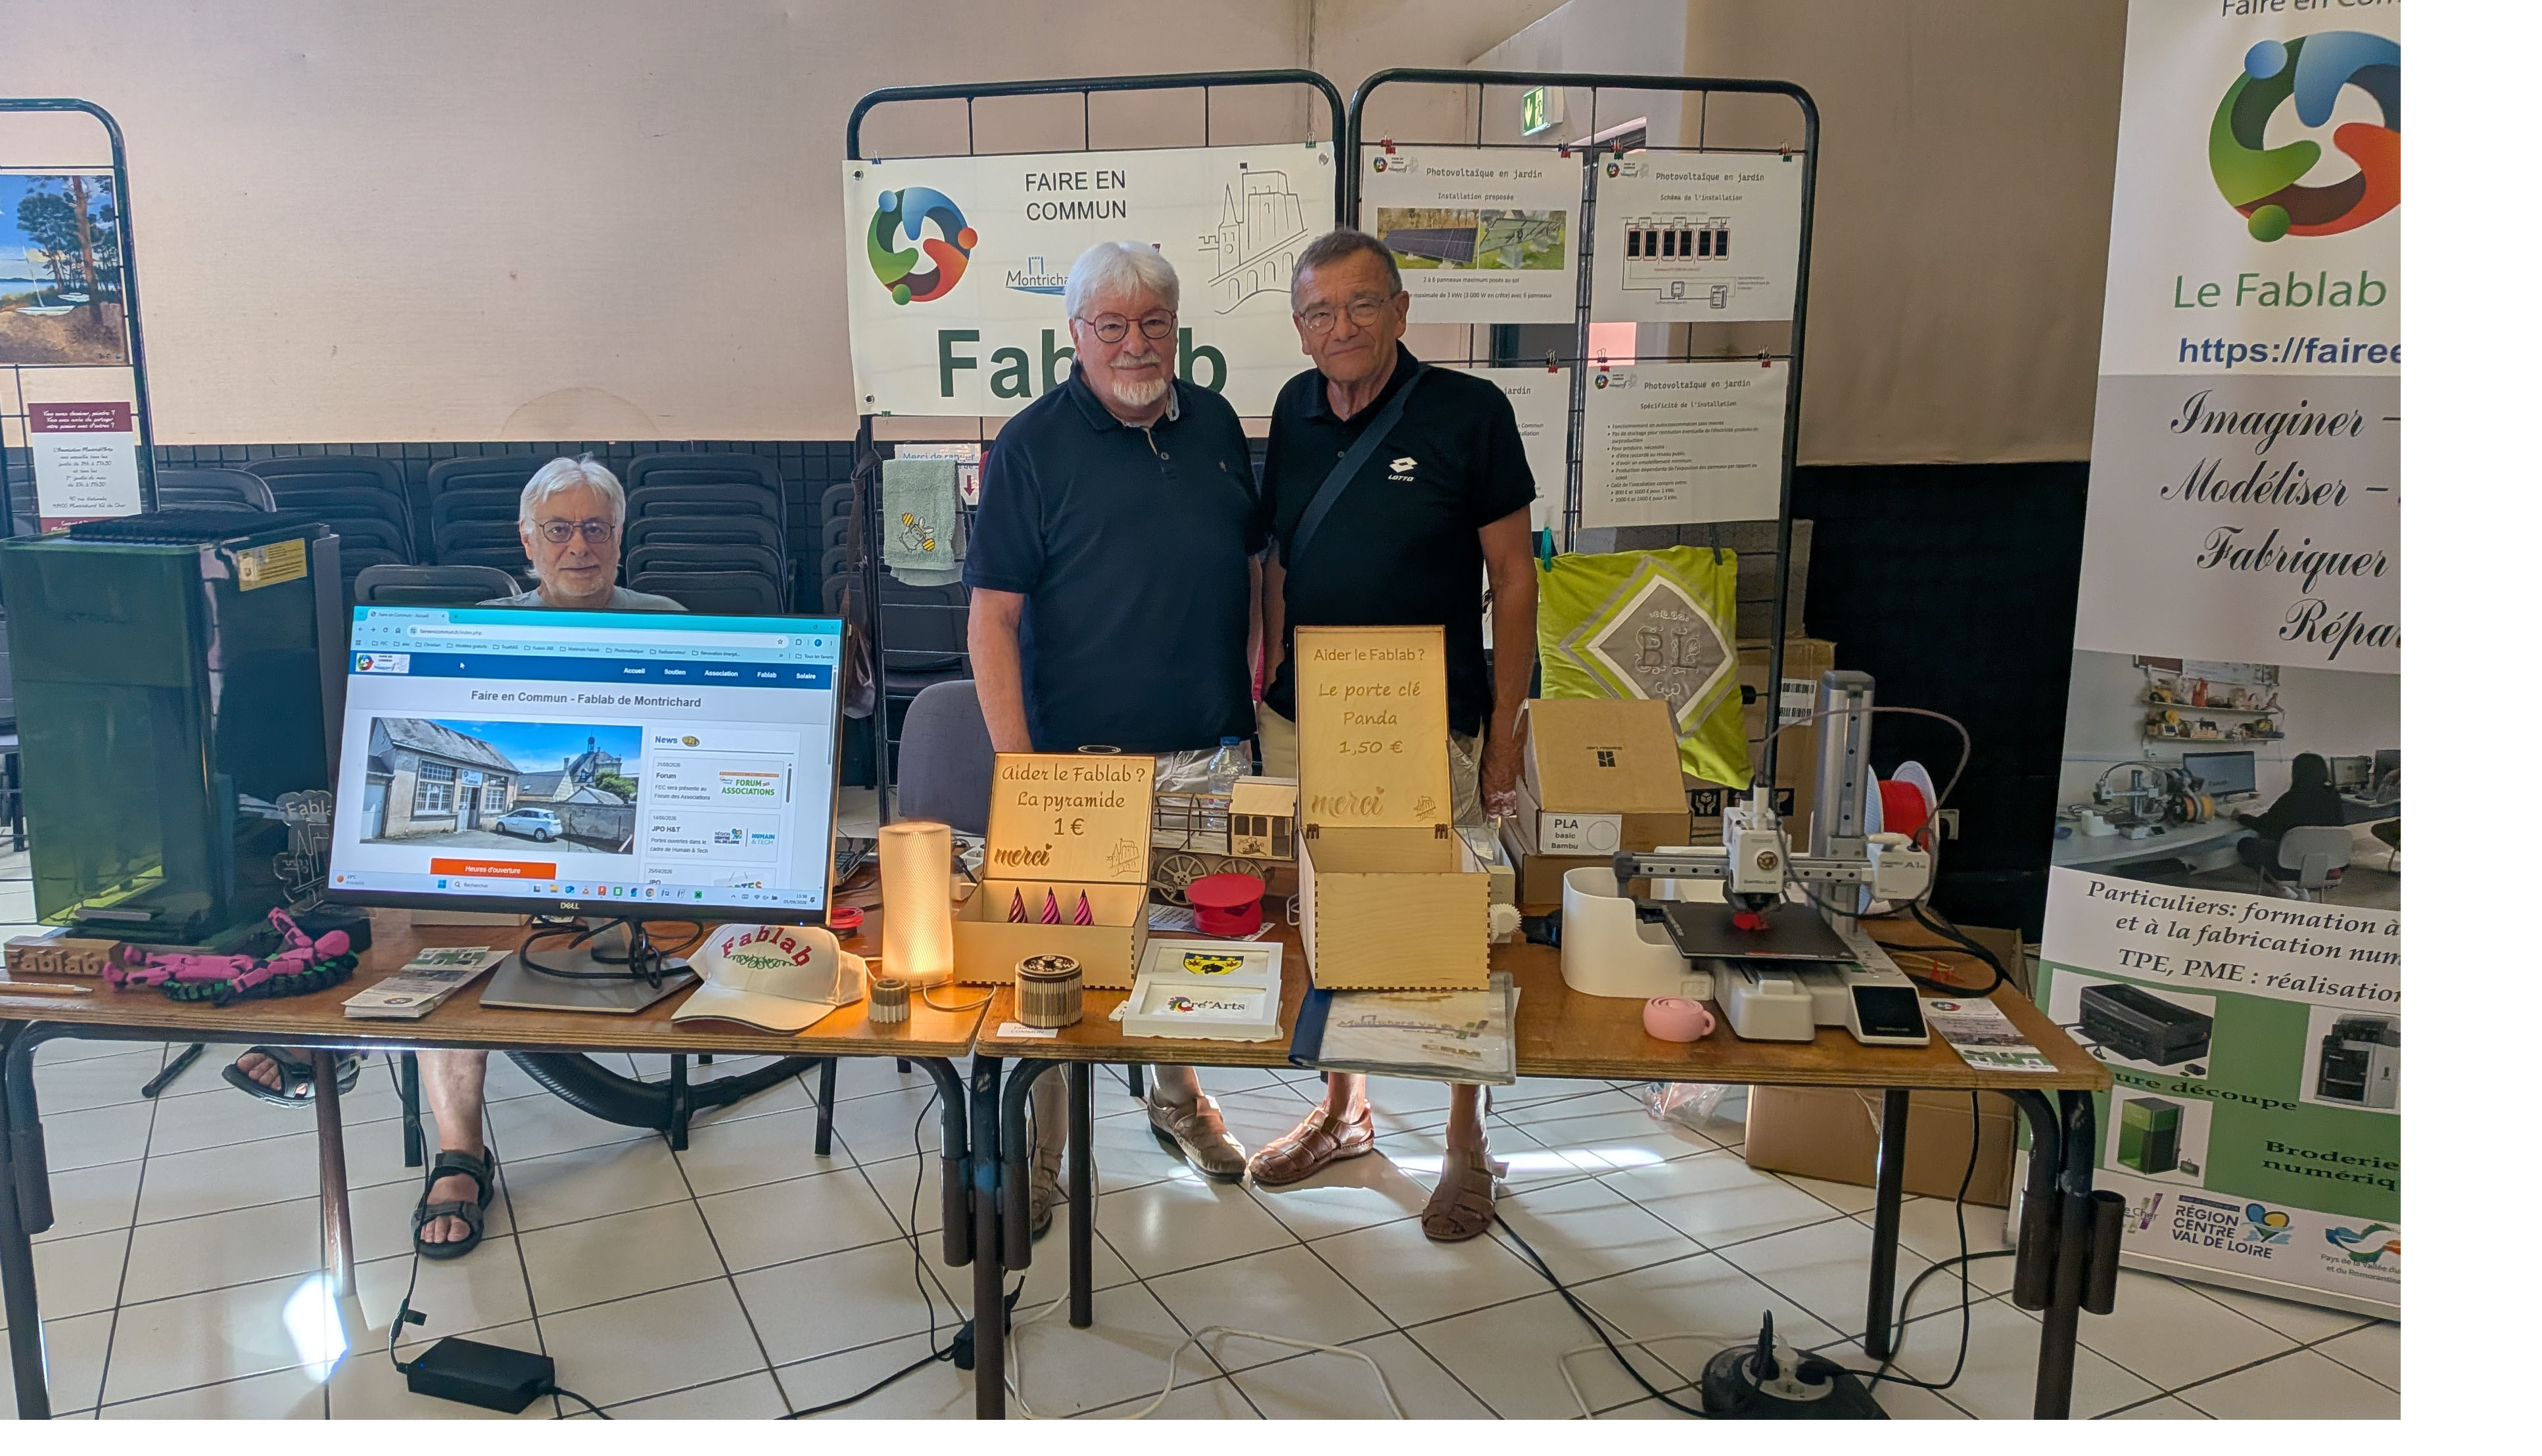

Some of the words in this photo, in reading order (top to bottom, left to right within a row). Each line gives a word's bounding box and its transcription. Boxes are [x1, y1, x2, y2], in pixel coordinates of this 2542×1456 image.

[1025, 171, 1091, 193] FAIRE
[1096, 169, 1127, 190] EN
[1426, 167, 1494, 179] Photovoltaïque
[1513, 169, 1543, 179] jardin
[1656, 172, 1720, 183] Photovoltaïque
[1738, 173, 1764, 183] jardin
[1025, 199, 1127, 222] COMMUN
[2175, 274, 2221, 309] Le
[2236, 270, 2387, 308] Fablab
[938, 327, 1227, 398] Fabb
[1643, 381, 1707, 390] Photovoltaïque
[1724, 379, 1751, 389] jardin
[2171, 390, 2365, 456] Imaginer
[2160, 458, 2349, 506] Modéliser
[2197, 526, 2390, 594] Fabriquer
[2279, 598, 2401, 661] Répa
[1313, 648, 1352, 661] Aider
[1355, 648, 1367, 661] le
[1370, 648, 1415, 661] Fablab
[1418, 648, 1424, 661] ?
[471, 690, 499, 701] Faire
[501, 693, 515, 702] en
[517, 692, 567, 703] Commun
[577, 693, 615, 705] Fablab
[617, 695, 631, 705] de
[634, 695, 701, 708] Montrichard
[1318, 684, 1337, 697] Le
[1344, 684, 1391, 702] porte
[1398, 681, 1421, 696] clé
[1344, 710, 1398, 726] Panda
[655, 735, 678, 744] News
[1338, 741, 1382, 756] 1,50
[1390, 740, 1403, 754] €
[1002, 763, 1050, 780] Aider
[1054, 764, 1068, 782] le
[1072, 764, 1131, 783] Fablab
[1136, 767, 1146, 783] ?
[721, 787, 775, 796] ASSOCIATIONS
[1018, 791, 1040, 807] La
[1043, 791, 1125, 812] pyramide
[1311, 786, 1386, 818] merci
[1054, 818, 1064, 835] 1
[1070, 818, 1085, 836] €
[1554, 818, 1579, 829] PLA
[993, 842, 1053, 868] merci
[464, 864, 486, 873] Heures
[487, 866, 521, 875] d'ouverture
[560, 901, 580, 910] DELL
[2086, 880, 2238, 917] Particuliers:
[2239, 901, 2375, 936] formation
[2384, 918, 2401, 937] à
[721, 925, 813, 968] Fablab
[2115, 915, 2139, 931] et
[2144, 917, 2159, 935] à
[2167, 920, 2190, 940] la
[2192, 923, 2342, 959] fabrication
[4, 947, 105, 976] Fablab
[2118, 947, 2174, 977] TPE,
[2181, 959, 2246, 983] PME
[2265, 1139, 2400, 1171] Broderie
[2175, 1205, 2239, 1227] RÉGION
[2173, 1217, 2236, 1239] CENTRE
[2172, 1229, 2200, 1244] VAL
[2203, 1235, 2224, 1249] DE
[2227, 1240, 2273, 1259] LOIRE
[2320, 1254, 2340, 1263] Pays
